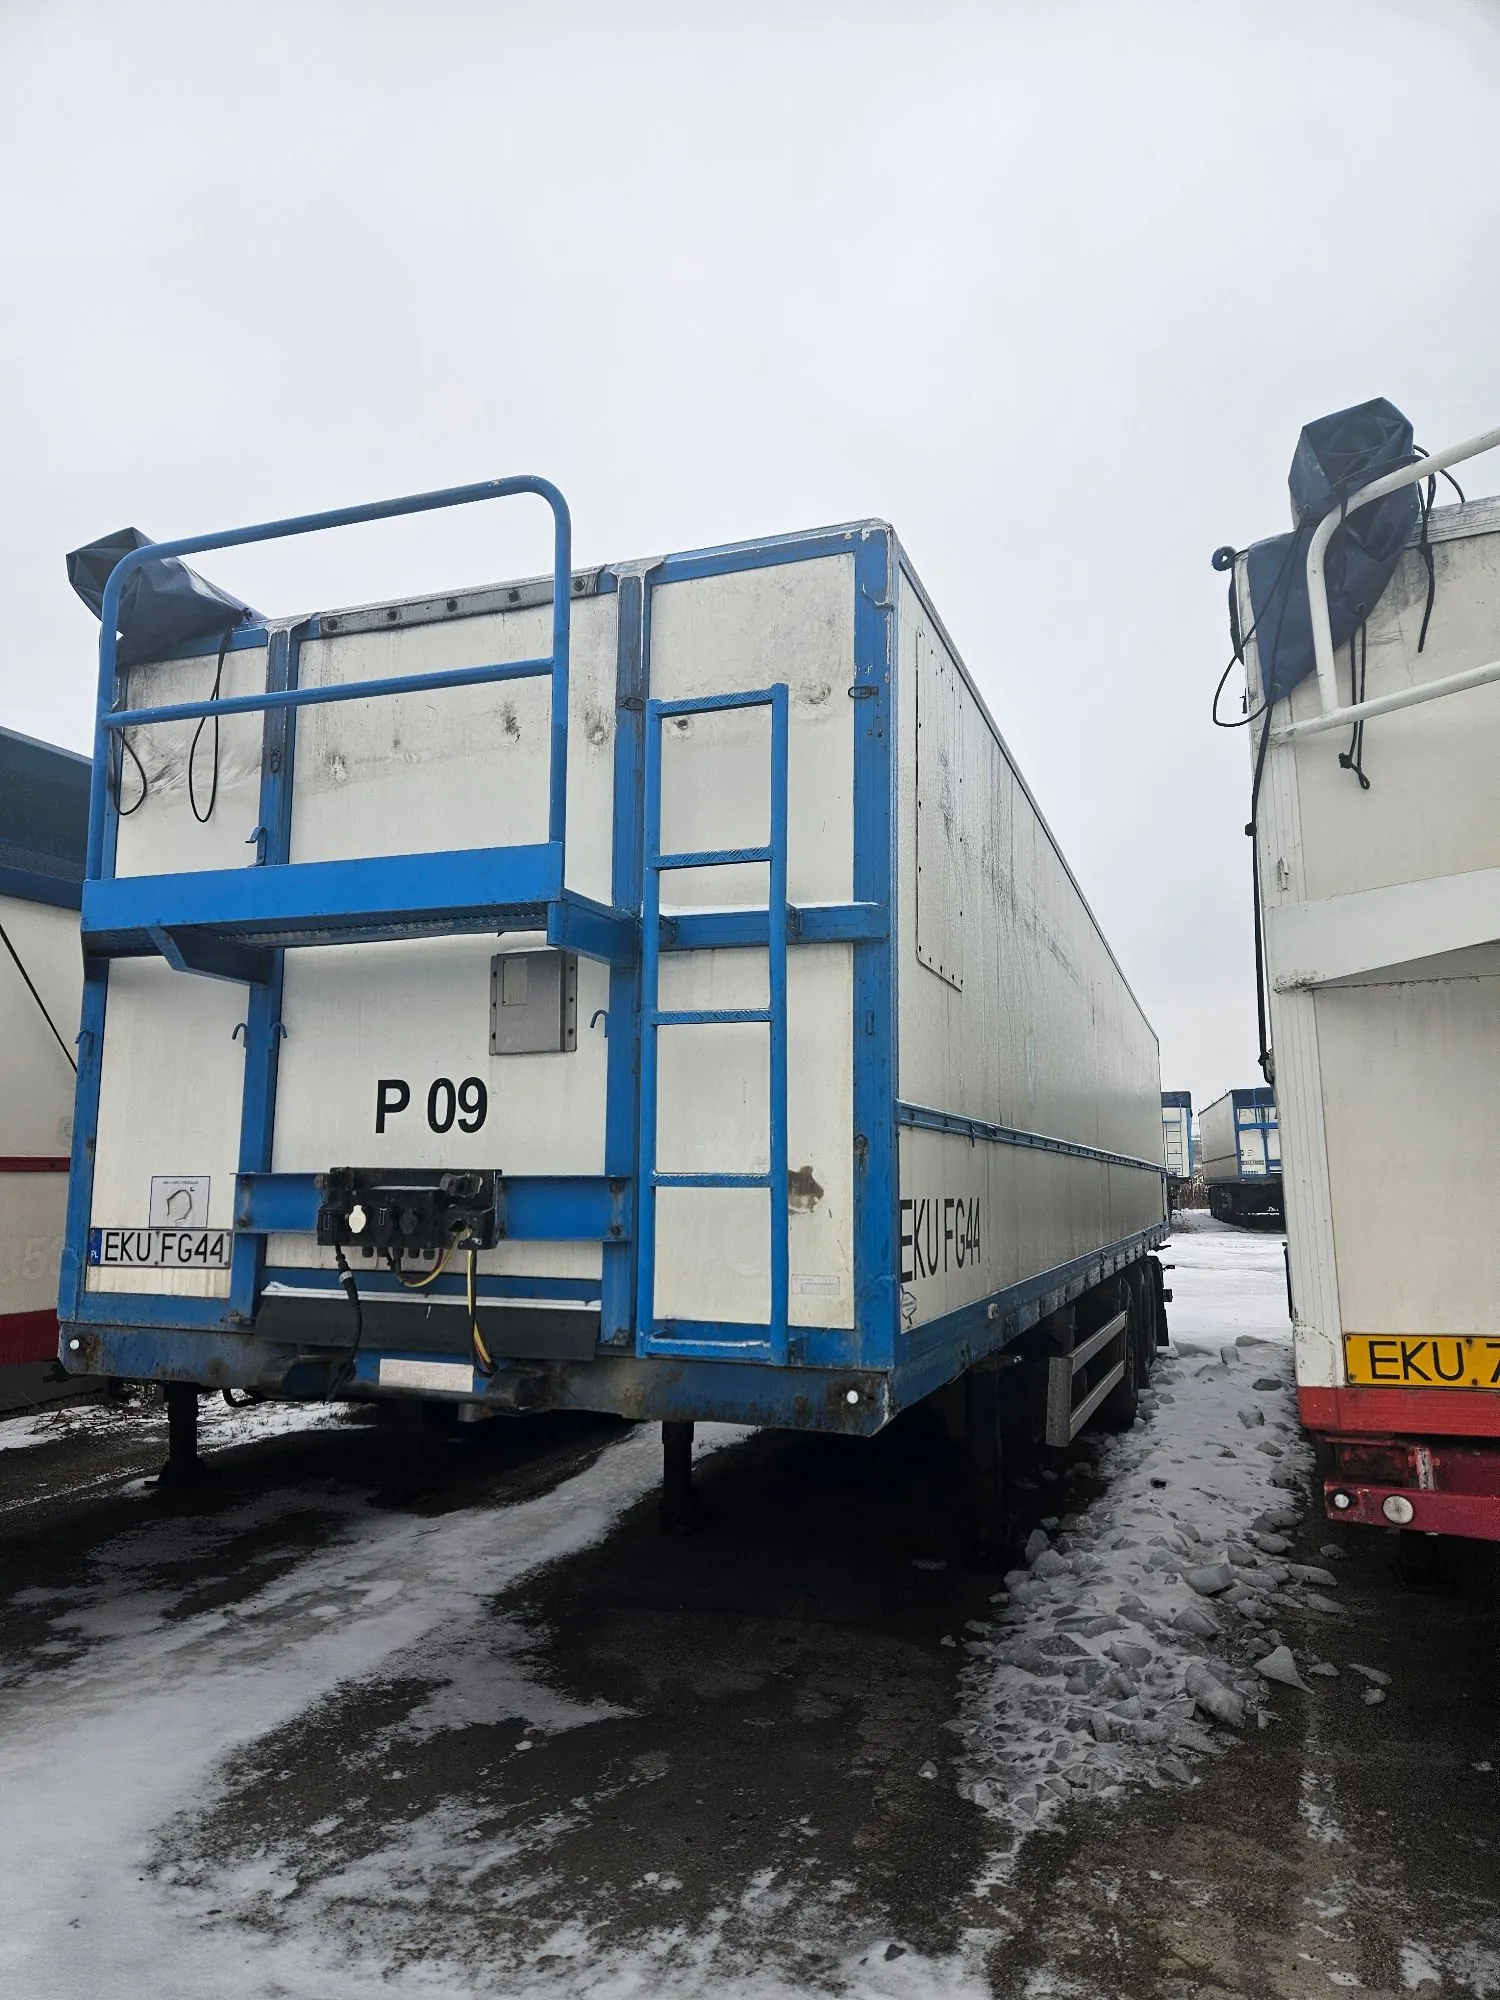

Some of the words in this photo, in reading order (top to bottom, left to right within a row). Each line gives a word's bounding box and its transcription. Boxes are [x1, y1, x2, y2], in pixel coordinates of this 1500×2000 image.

[375, 1079, 410, 1133] P
[427, 1076, 488, 1134] 09
[90, 1250, 99, 1259] PL
[104, 1231, 152, 1262] EKU
[160, 1232, 224, 1263] FG44
[899, 1198, 940, 1284] EKU
[944, 1197, 981, 1273] FG44
[1368, 1340, 1465, 1381] EKU
